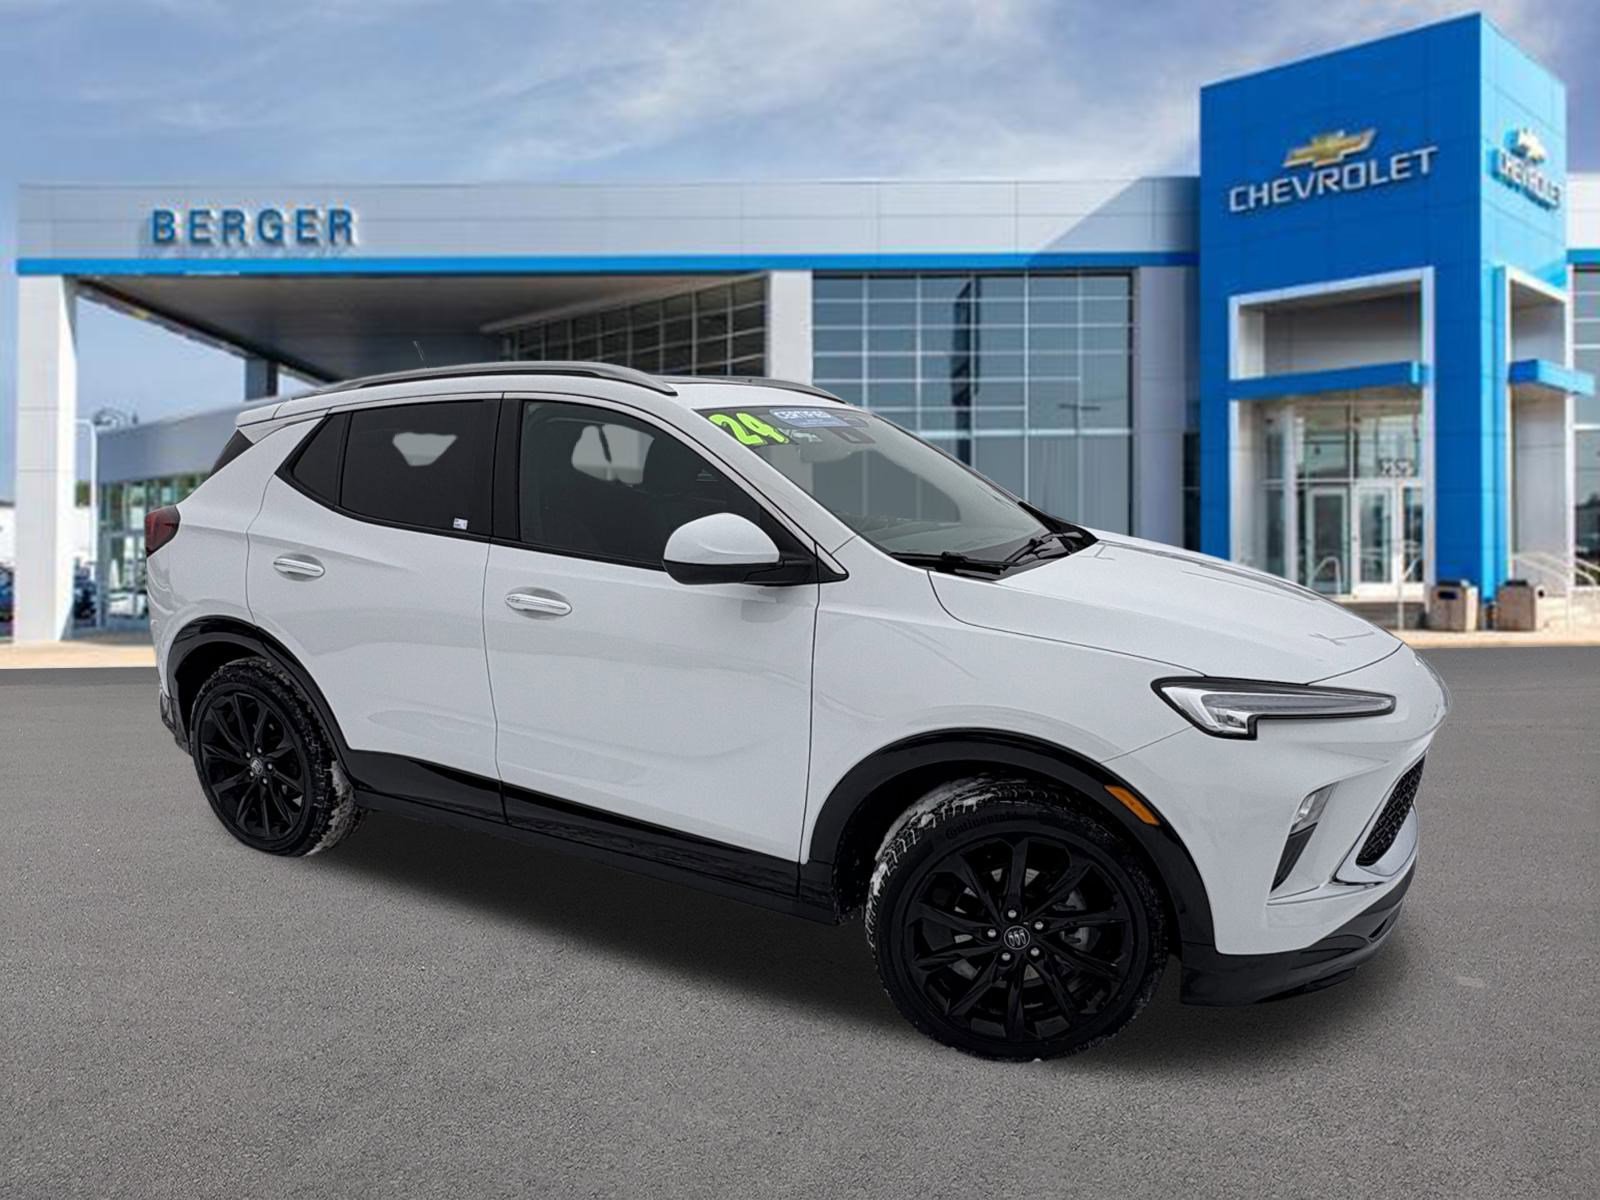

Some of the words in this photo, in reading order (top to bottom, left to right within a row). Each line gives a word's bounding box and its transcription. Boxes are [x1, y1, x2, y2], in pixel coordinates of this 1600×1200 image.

[1229, 145, 1438, 212] CHEVROLET
[152, 208, 355, 245] BERGER
[708, 411, 790, 445] 24
